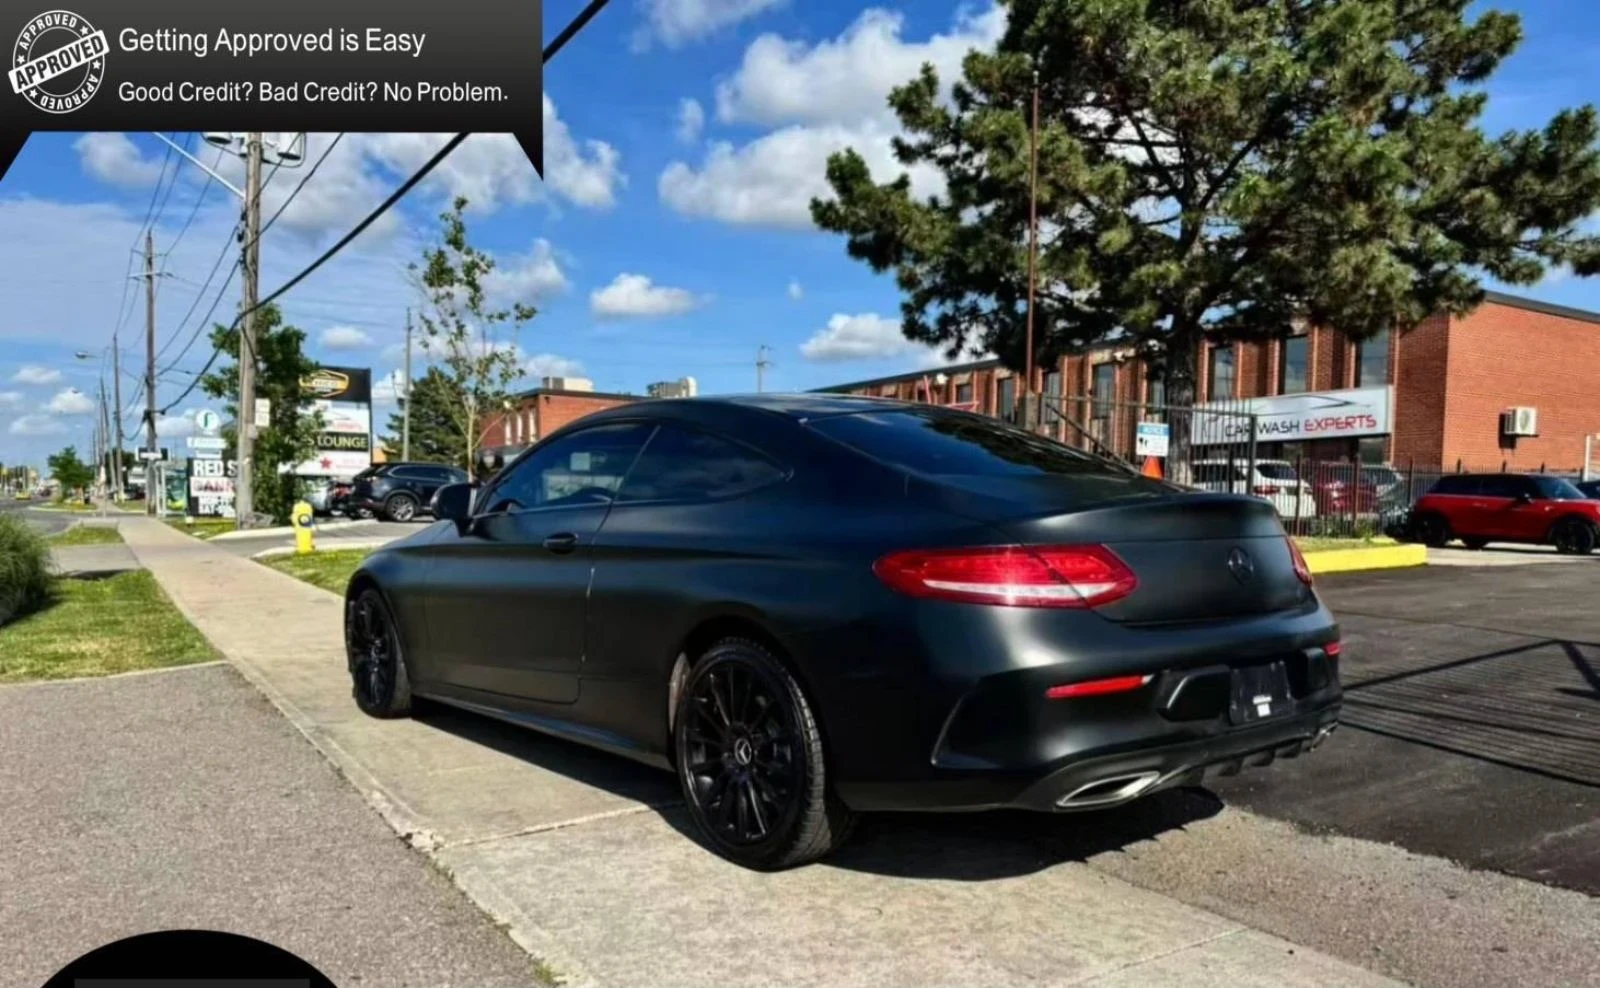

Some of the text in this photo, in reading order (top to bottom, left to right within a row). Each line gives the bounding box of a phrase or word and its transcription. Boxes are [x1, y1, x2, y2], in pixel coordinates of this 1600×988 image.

[1256, 419, 1300, 435] WASH
[1304, 414, 1378, 432] EXPERTS
[316, 434, 368, 449] LOUNGE
[193, 459, 224, 477] RED
